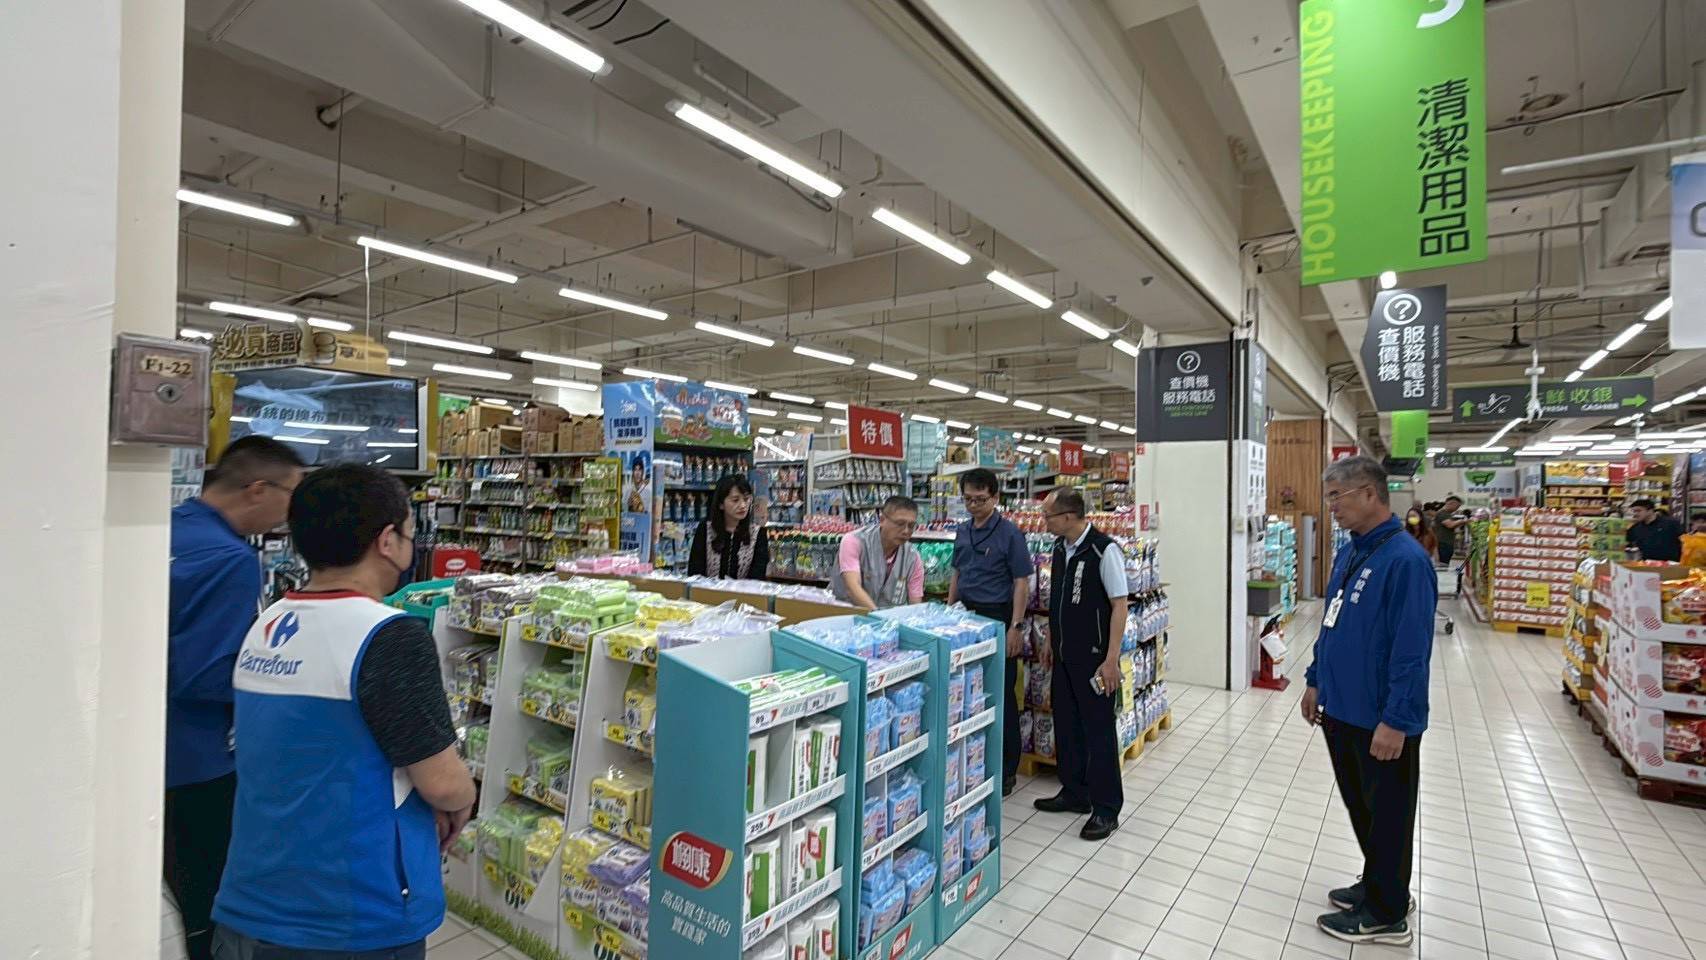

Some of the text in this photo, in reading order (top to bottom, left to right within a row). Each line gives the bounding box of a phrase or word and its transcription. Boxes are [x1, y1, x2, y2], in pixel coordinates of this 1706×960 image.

[1301, 9, 1336, 278] HOUSEKEEPING
[1417, 78, 1470, 258] 清潔用品
[222, 323, 297, 359] 必買商品
[1378, 327, 1401, 382] 查價機
[1402, 325, 1426, 398] 服務電話
[1162, 388, 1216, 405] 服務電話
[1169, 374, 1210, 390] 查價機
[861, 418, 894, 447] 特價
[239, 648, 303, 676] Carrefour
[660, 889, 732, 938] 高品質生活的
